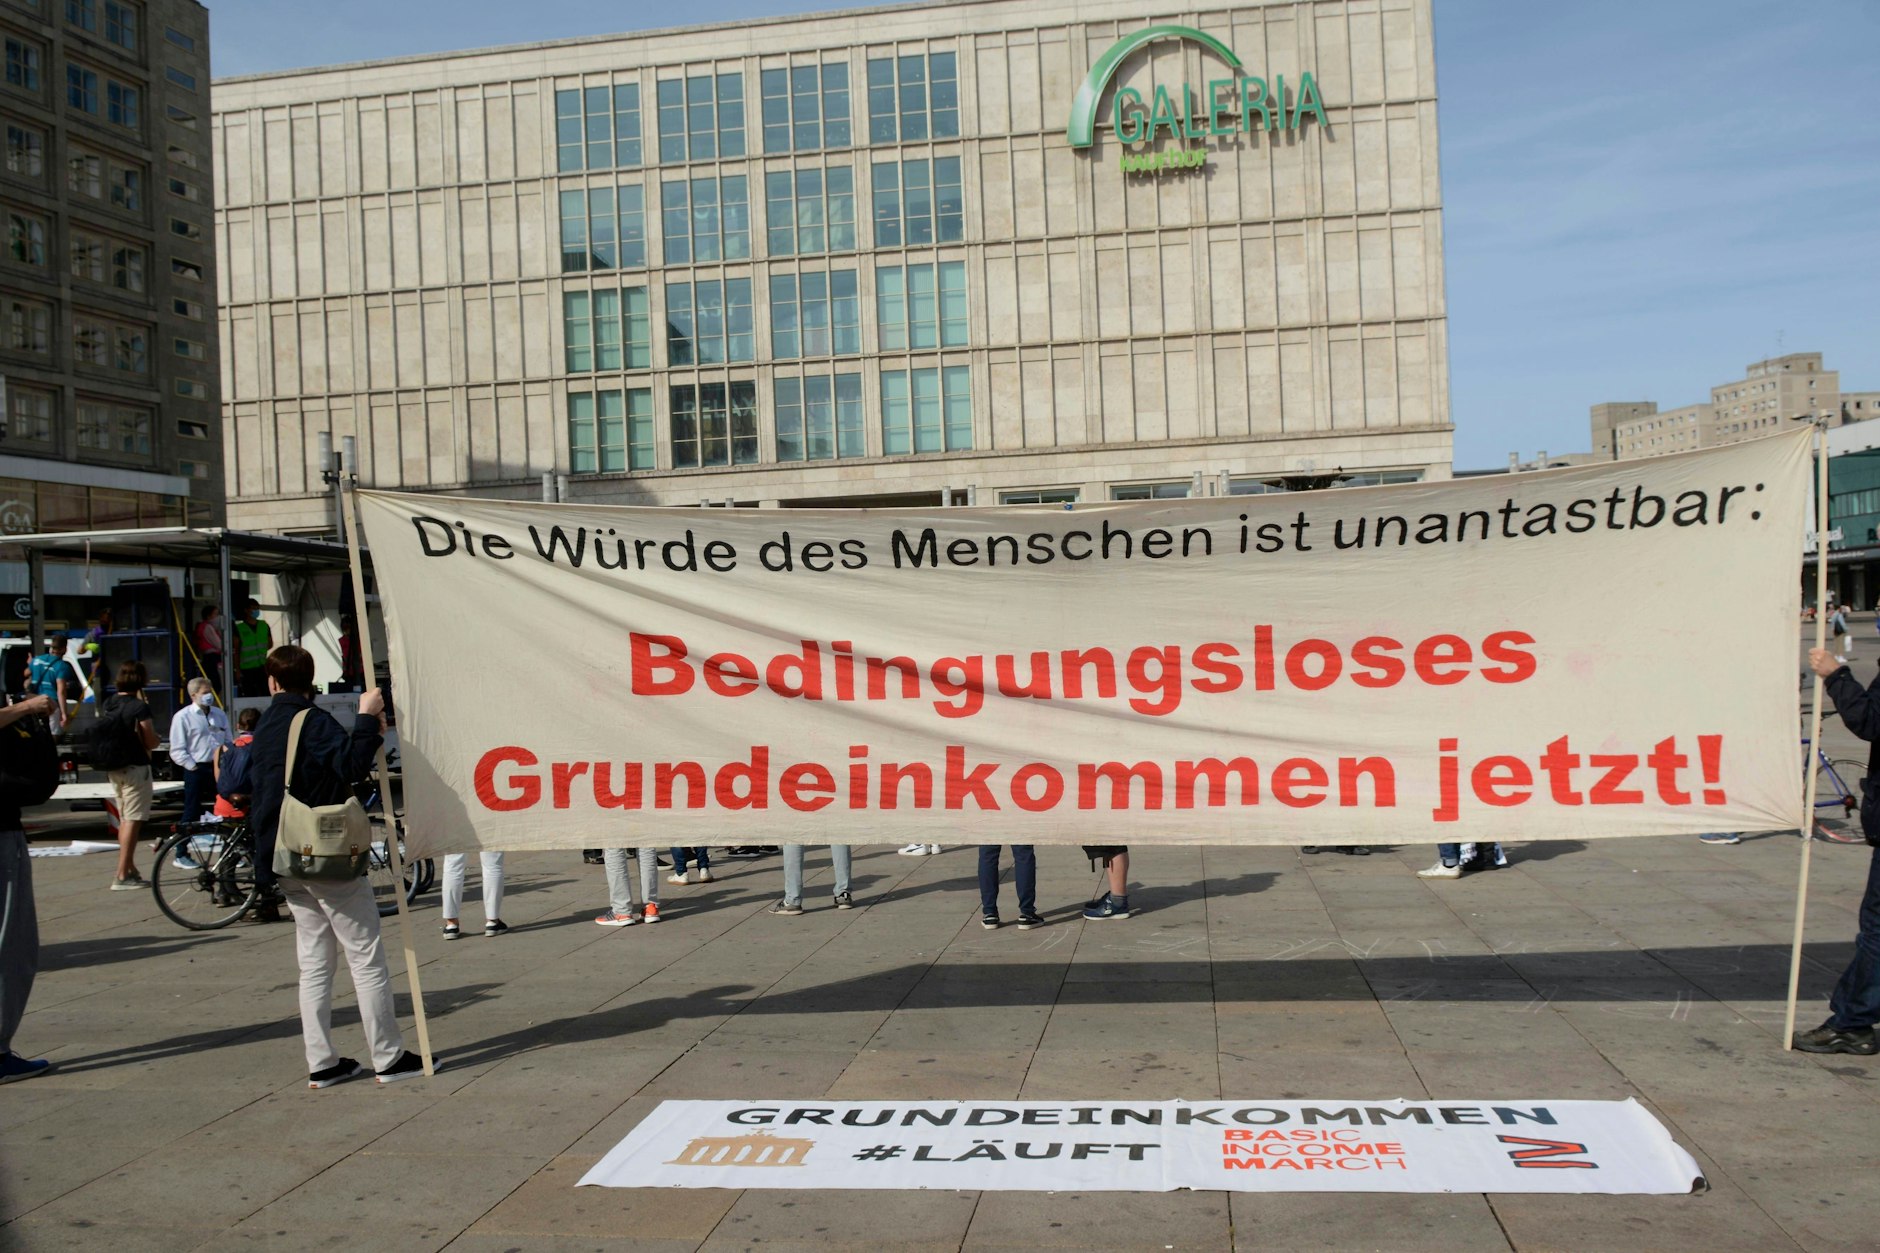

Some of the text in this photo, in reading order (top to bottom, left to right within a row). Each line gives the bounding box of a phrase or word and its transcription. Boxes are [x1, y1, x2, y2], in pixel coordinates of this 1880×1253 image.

[1113, 71, 1328, 145] GALERIA
[682, 397, 758, 420] RELAX
[411, 482, 1766, 572] Die Würde des Menschen ist unantastbar:
[628, 624, 1539, 720] Bedingungsloses
[473, 733, 1729, 824] Grundeinkommen jetzt!
[726, 1106, 1558, 1127] GRUNDEINKOMMEN
[1223, 1129, 1362, 1142] BASIC
[852, 1139, 1161, 1162] #LÄUFT
[1222, 1143, 1406, 1156] INCOME
[1223, 1157, 1407, 1171] MARCH
